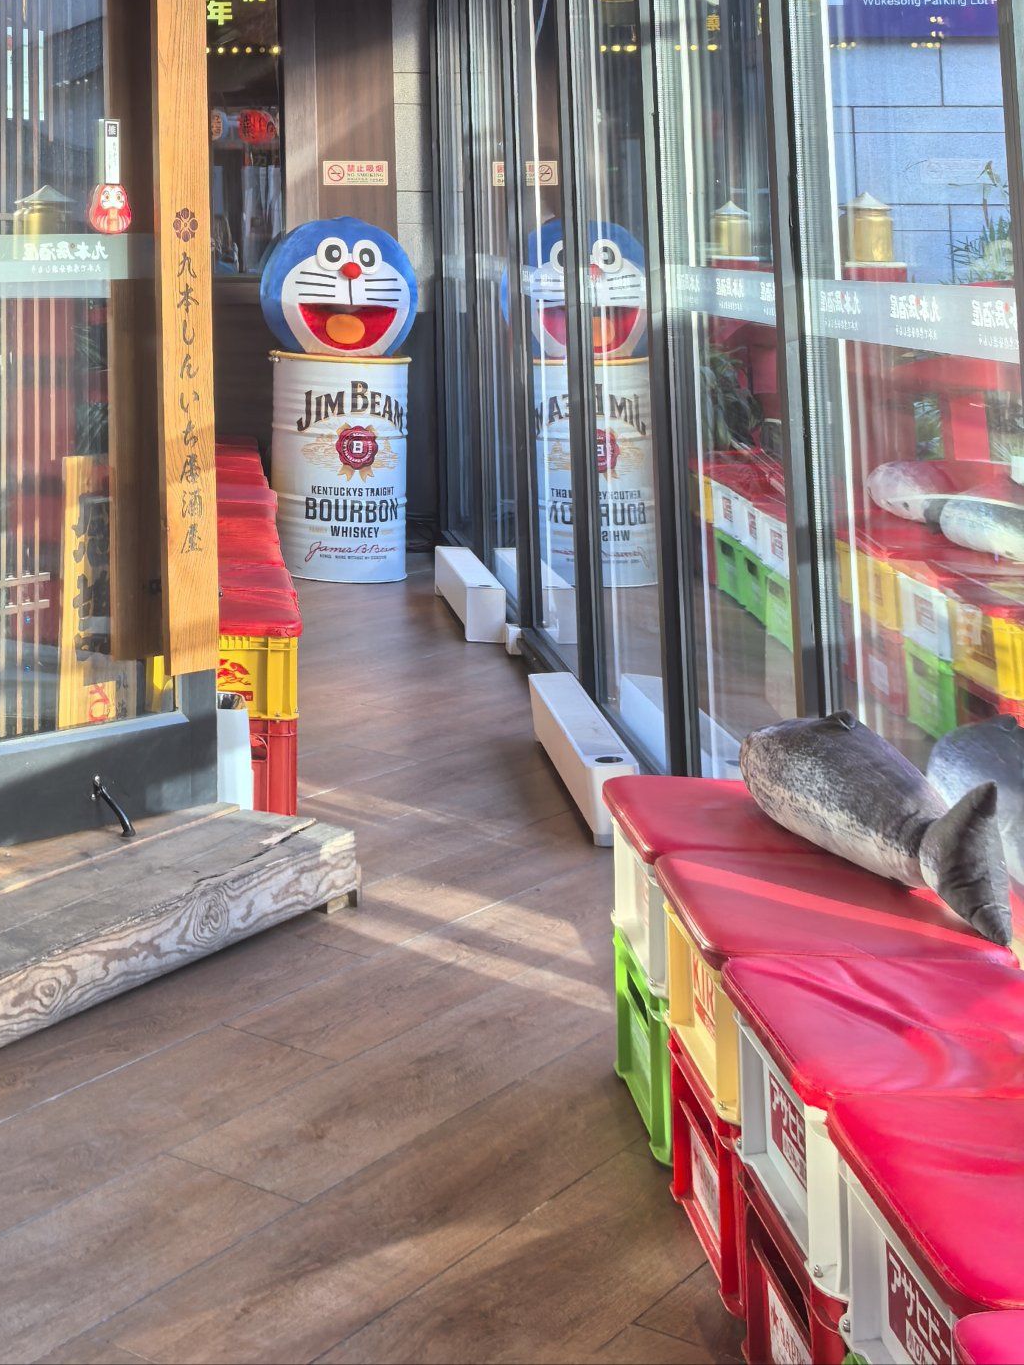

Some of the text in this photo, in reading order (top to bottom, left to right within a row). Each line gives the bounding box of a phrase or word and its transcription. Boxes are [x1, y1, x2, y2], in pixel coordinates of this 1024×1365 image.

[346, 164, 384, 173] 禁止吸烟
[296, 389, 346, 432] JIM
[304, 497, 399, 524] BOURBON
[331, 525, 380, 539] WHISKEY
